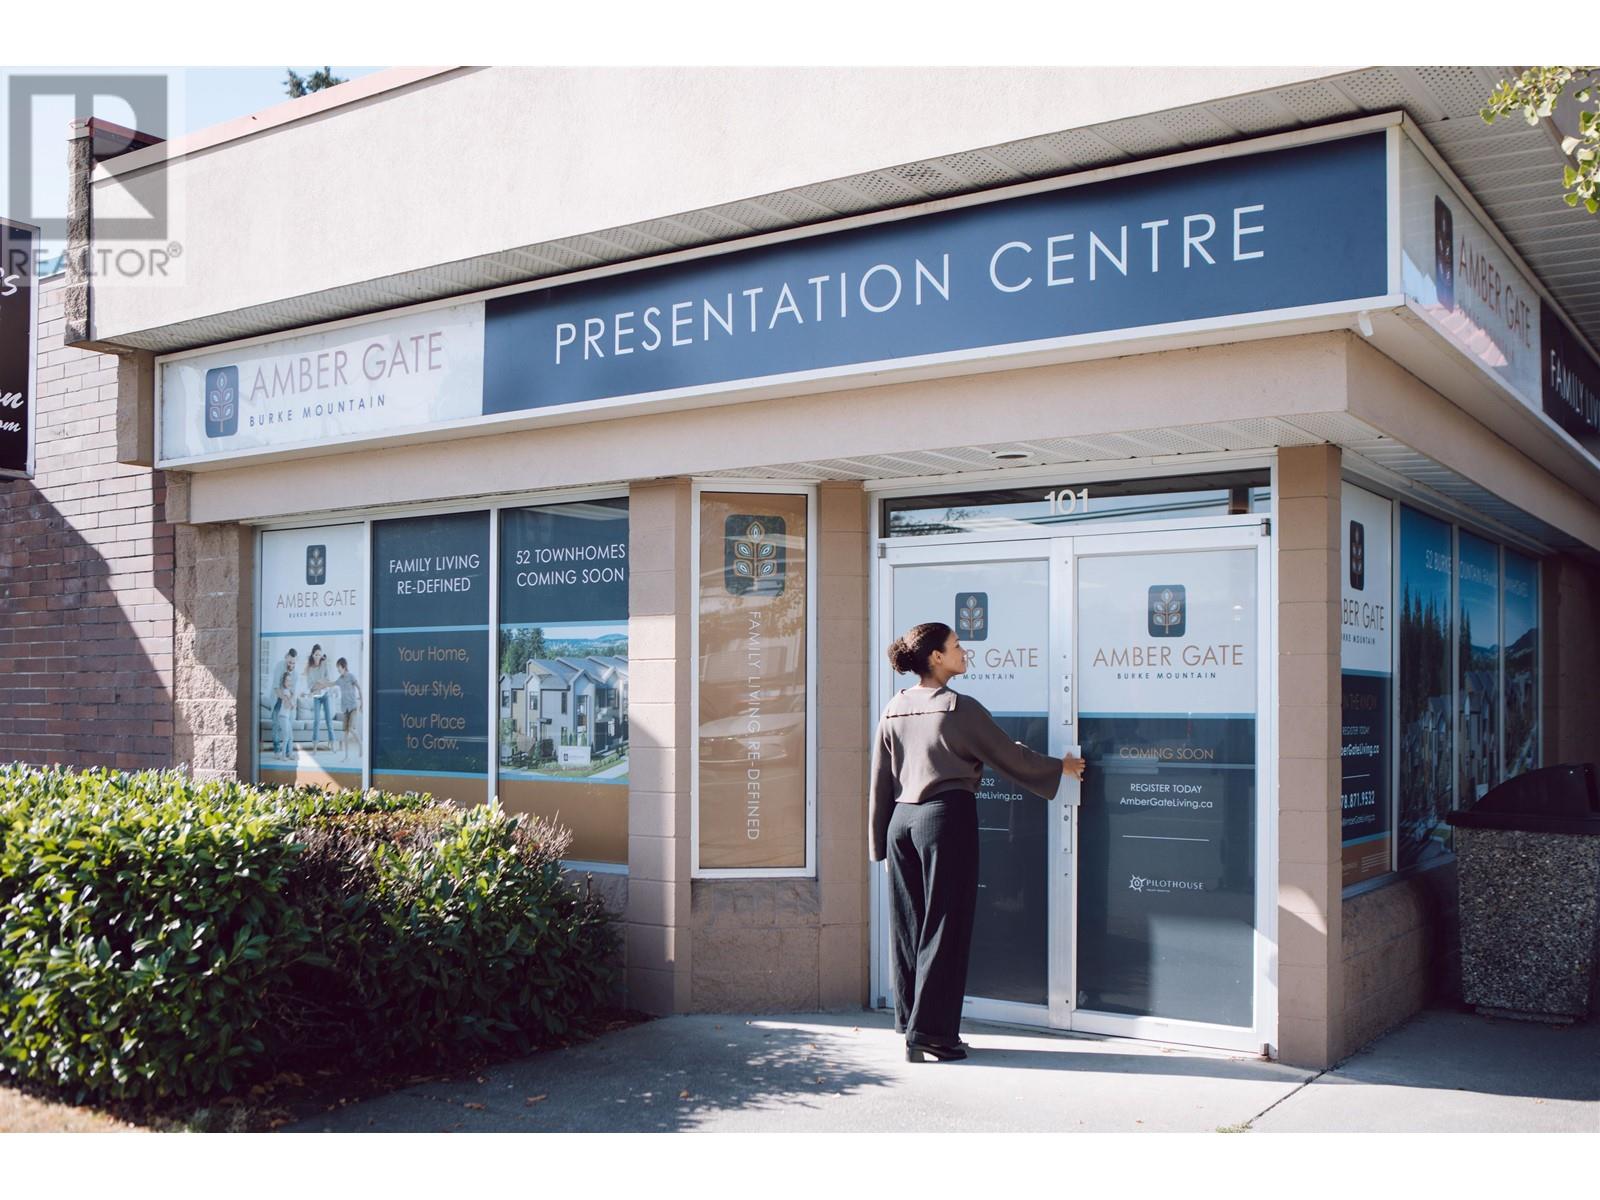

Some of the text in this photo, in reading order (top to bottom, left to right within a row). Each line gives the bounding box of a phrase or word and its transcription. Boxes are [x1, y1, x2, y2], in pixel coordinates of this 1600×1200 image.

[554, 203, 1267, 365] PRESENTATION CENTRE
[1458, 234, 1502, 318] AMBER
[1504, 284, 1531, 349] GATE
[249, 331, 443, 401] AMBER GATE
[1550, 348, 1584, 416] FAMILY
[249, 394, 386, 427] BURKE MOUNTAIN
[1044, 488, 1090, 515] 101
[389, 554, 480, 573] FAMILY LIVING
[516, 544, 626, 565] 52 TOWNHOMES
[397, 578, 471, 595] RE-DEFINED
[517, 567, 624, 587] COMING SOON
[276, 589, 357, 609] AMBER GATE
[1343, 598, 1384, 631] BER GATE
[399, 647, 470, 663] Your Home,
[984, 647, 1039, 668] GATE
[1093, 644, 1244, 668] AMBER GATE
[1157, 672, 1217, 680] MOUNTAIN
[403, 680, 464, 699] Your Style,
[401, 713, 466, 730] Your Place
[747, 611, 761, 840] FAMILY LIVING RE-DEFINED
[407, 733, 460, 750] to Grow.
[1119, 747, 1214, 760] COMING SOON
[1130, 783, 1202, 794] REGISTER TODAY
[1120, 797, 1213, 810] AmberGateLiving.ca
[1146, 879, 1205, 890] PILOTHOUSE
